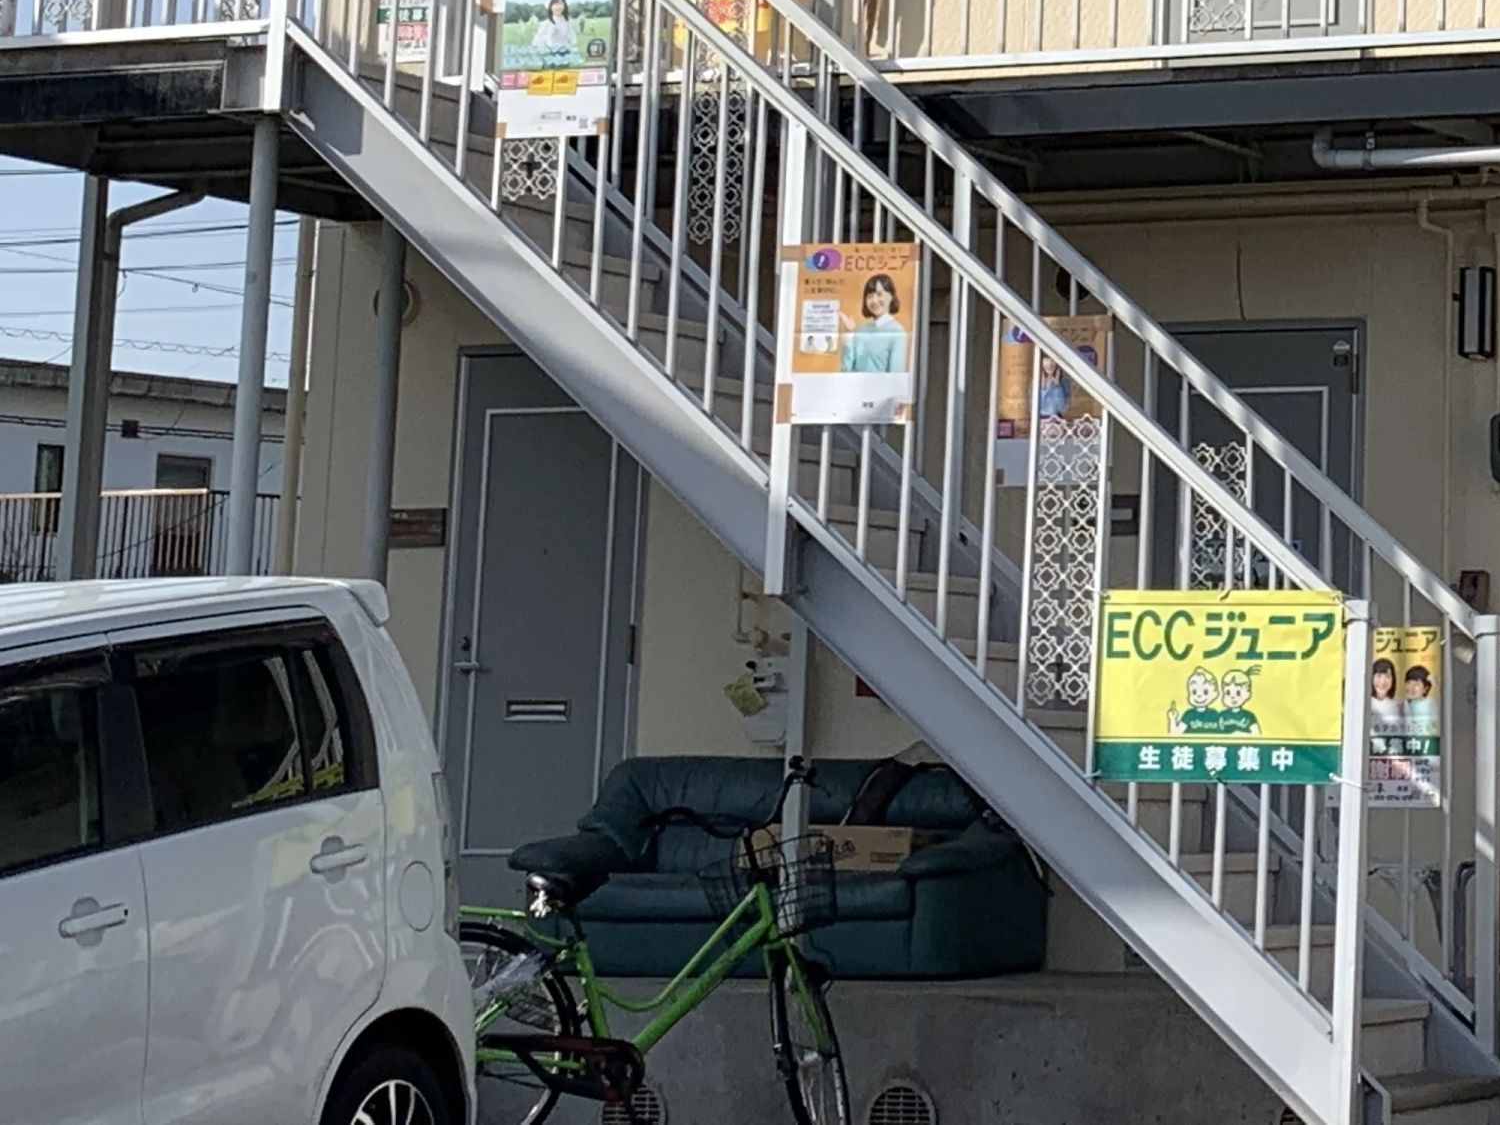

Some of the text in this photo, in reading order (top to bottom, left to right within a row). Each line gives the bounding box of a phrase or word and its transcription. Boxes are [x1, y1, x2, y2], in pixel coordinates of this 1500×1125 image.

[1106, 609, 1336, 661] ECCジュニア
[1138, 746, 1294, 772] 生徒募集中
